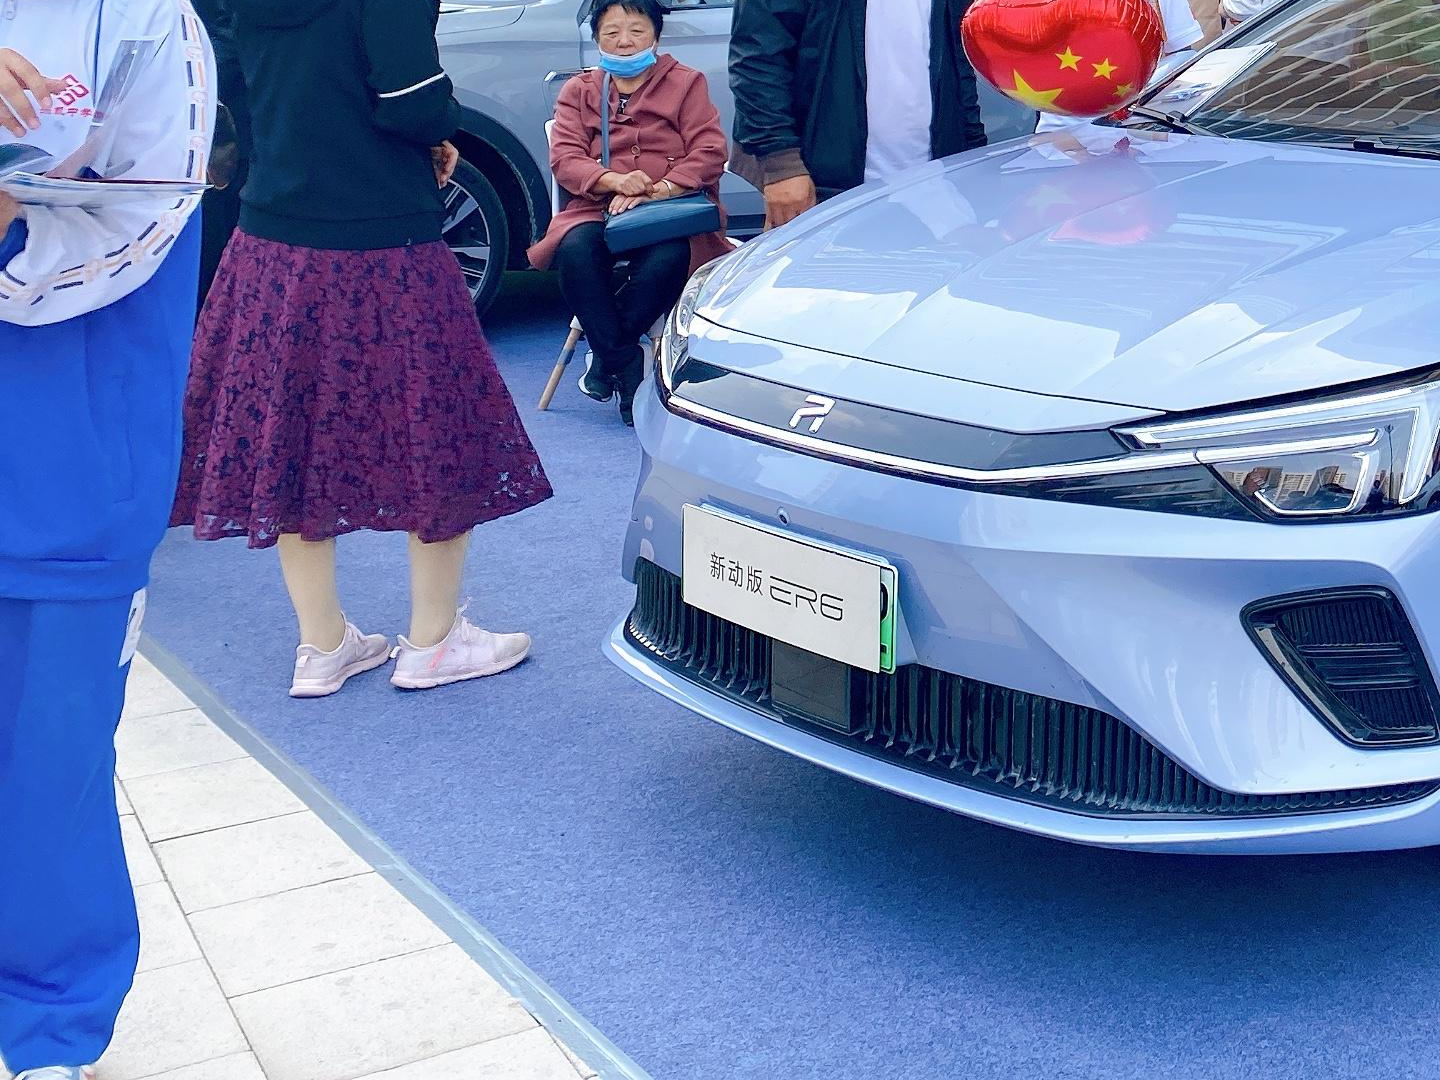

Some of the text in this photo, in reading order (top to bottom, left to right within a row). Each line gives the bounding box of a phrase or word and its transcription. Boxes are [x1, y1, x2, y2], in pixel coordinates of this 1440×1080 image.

[710, 551, 844, 621] 新动版 ER6
